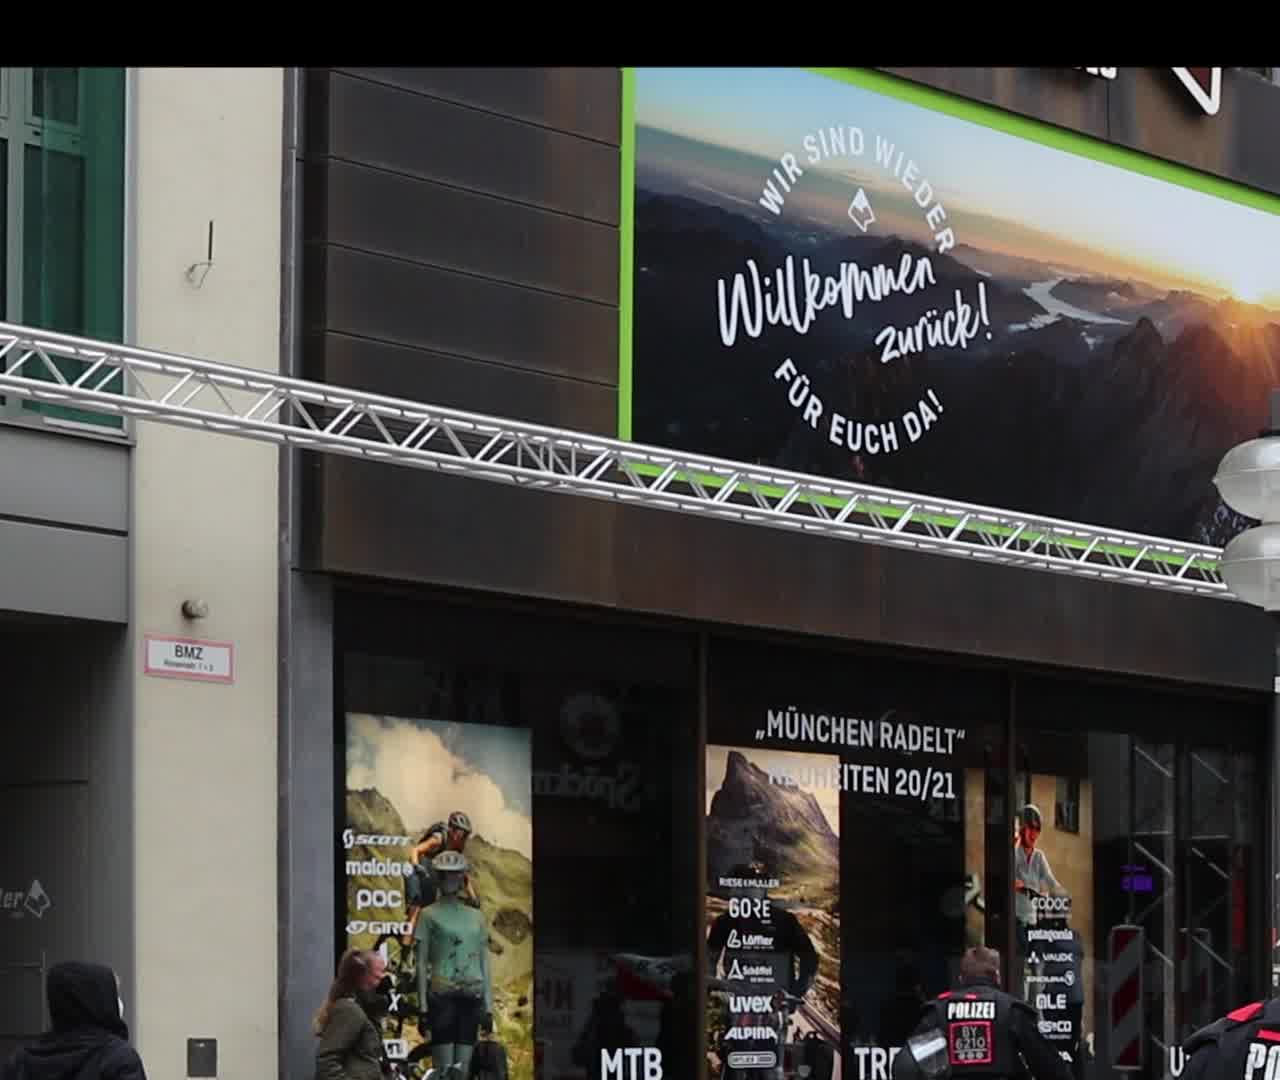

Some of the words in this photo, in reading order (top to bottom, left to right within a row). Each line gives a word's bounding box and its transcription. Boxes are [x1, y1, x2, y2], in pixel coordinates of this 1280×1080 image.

[760, 152, 804, 216] WIR
[803, 125, 865, 165] SIND
[875, 135, 955, 254] WIEDER
[717, 254, 937, 347] Willkommen
[875, 281, 993, 364] zurück!
[774, 358, 824, 429] FÜR
[829, 412, 900, 455] EUCH
[902, 388, 944, 443] DA!
[174, 644, 203, 660] BMZ
[895, 766, 956, 801] 20/21
[728, 896, 771, 919] GORE
[368, 921, 414, 936] GIRO
[1027, 928, 1073, 943] patagonia
[729, 994, 773, 1014] uvex
[947, 1001, 996, 1020] POLIZEI
